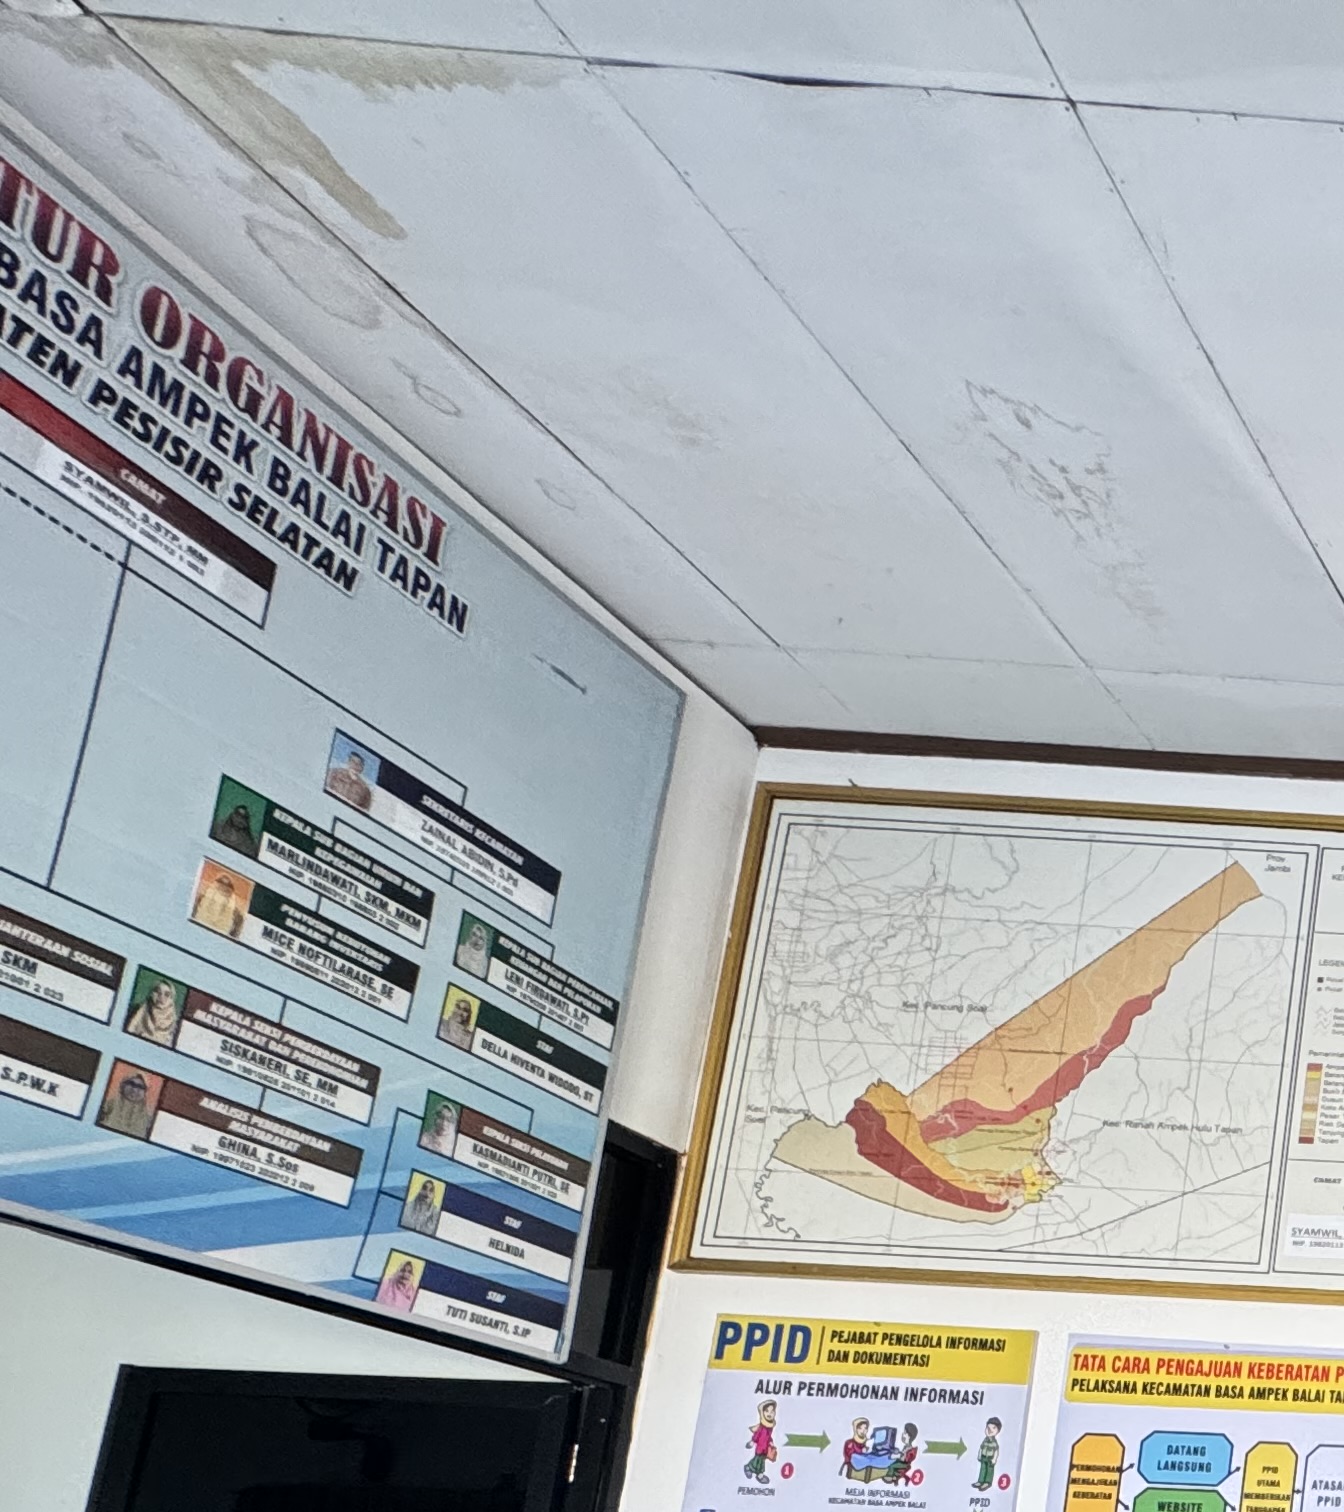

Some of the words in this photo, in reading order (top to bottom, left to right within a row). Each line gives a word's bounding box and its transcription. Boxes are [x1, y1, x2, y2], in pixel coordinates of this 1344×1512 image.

[0, 241, 103, 361] BASA
[117, 345, 261, 476] AMPEK
[267, 455, 366, 557] BALAI
[376, 536, 468, 634] TAPAN
[140, 286, 447, 567] ORGANISASI
[0, 304, 82, 387] TEN
[88, 377, 223, 494] PESISIR
[228, 483, 359, 592] SELATAN
[261, 924, 295, 947] MICE
[2, 950, 38, 974] SKM
[481, 1038, 509, 1060] DELLA
[583, 1090, 595, 1103] ST
[316, 1078, 339, 1096] MM
[218, 1136, 261, 1159] GHINA,
[1291, 1227, 1342, 1240] SYAMWIL,
[446, 1305, 468, 1321] TUTI
[469, 1312, 510, 1334] SUSANTI,
[714, 1320, 813, 1365] PPID
[829, 1330, 879, 1346] PEJABAT
[880, 1332, 943, 1349] PENGELOLA
[945, 1335, 1006, 1352] INFORMASI
[826, 1349, 850, 1364] DAN
[852, 1350, 930, 1368] DOKUMENTASI
[1072, 1353, 1107, 1373] TATA
[1111, 1355, 1151, 1375] CARA
[1155, 1358, 1243, 1379] PENGAJUAN
[1247, 1361, 1331, 1383] KEBERATAN
[754, 1378, 792, 1396] ALUR
[797, 1381, 899, 1402] PERMOHONAN
[904, 1386, 985, 1406] INFORMASI
[1071, 1377, 1139, 1395] PELAKSANA
[1141, 1381, 1212, 1398] KECAMATAN
[1214, 1385, 1245, 1400] BASA
[1248, 1386, 1289, 1402] AMPEK
[1291, 1388, 1325, 1403] BALAI
[1166, 1444, 1206, 1457] DATANG
[1157, 1459, 1212, 1473] LANGSUNG
[1262, 1465, 1279, 1474] PPID
[737, 1486, 776, 1497] PEMOHON
[1256, 1479, 1280, 1488] UTAMA
[969, 1497, 991, 1507] PPID
[1316, 1496, 1342, 1508] PPID
